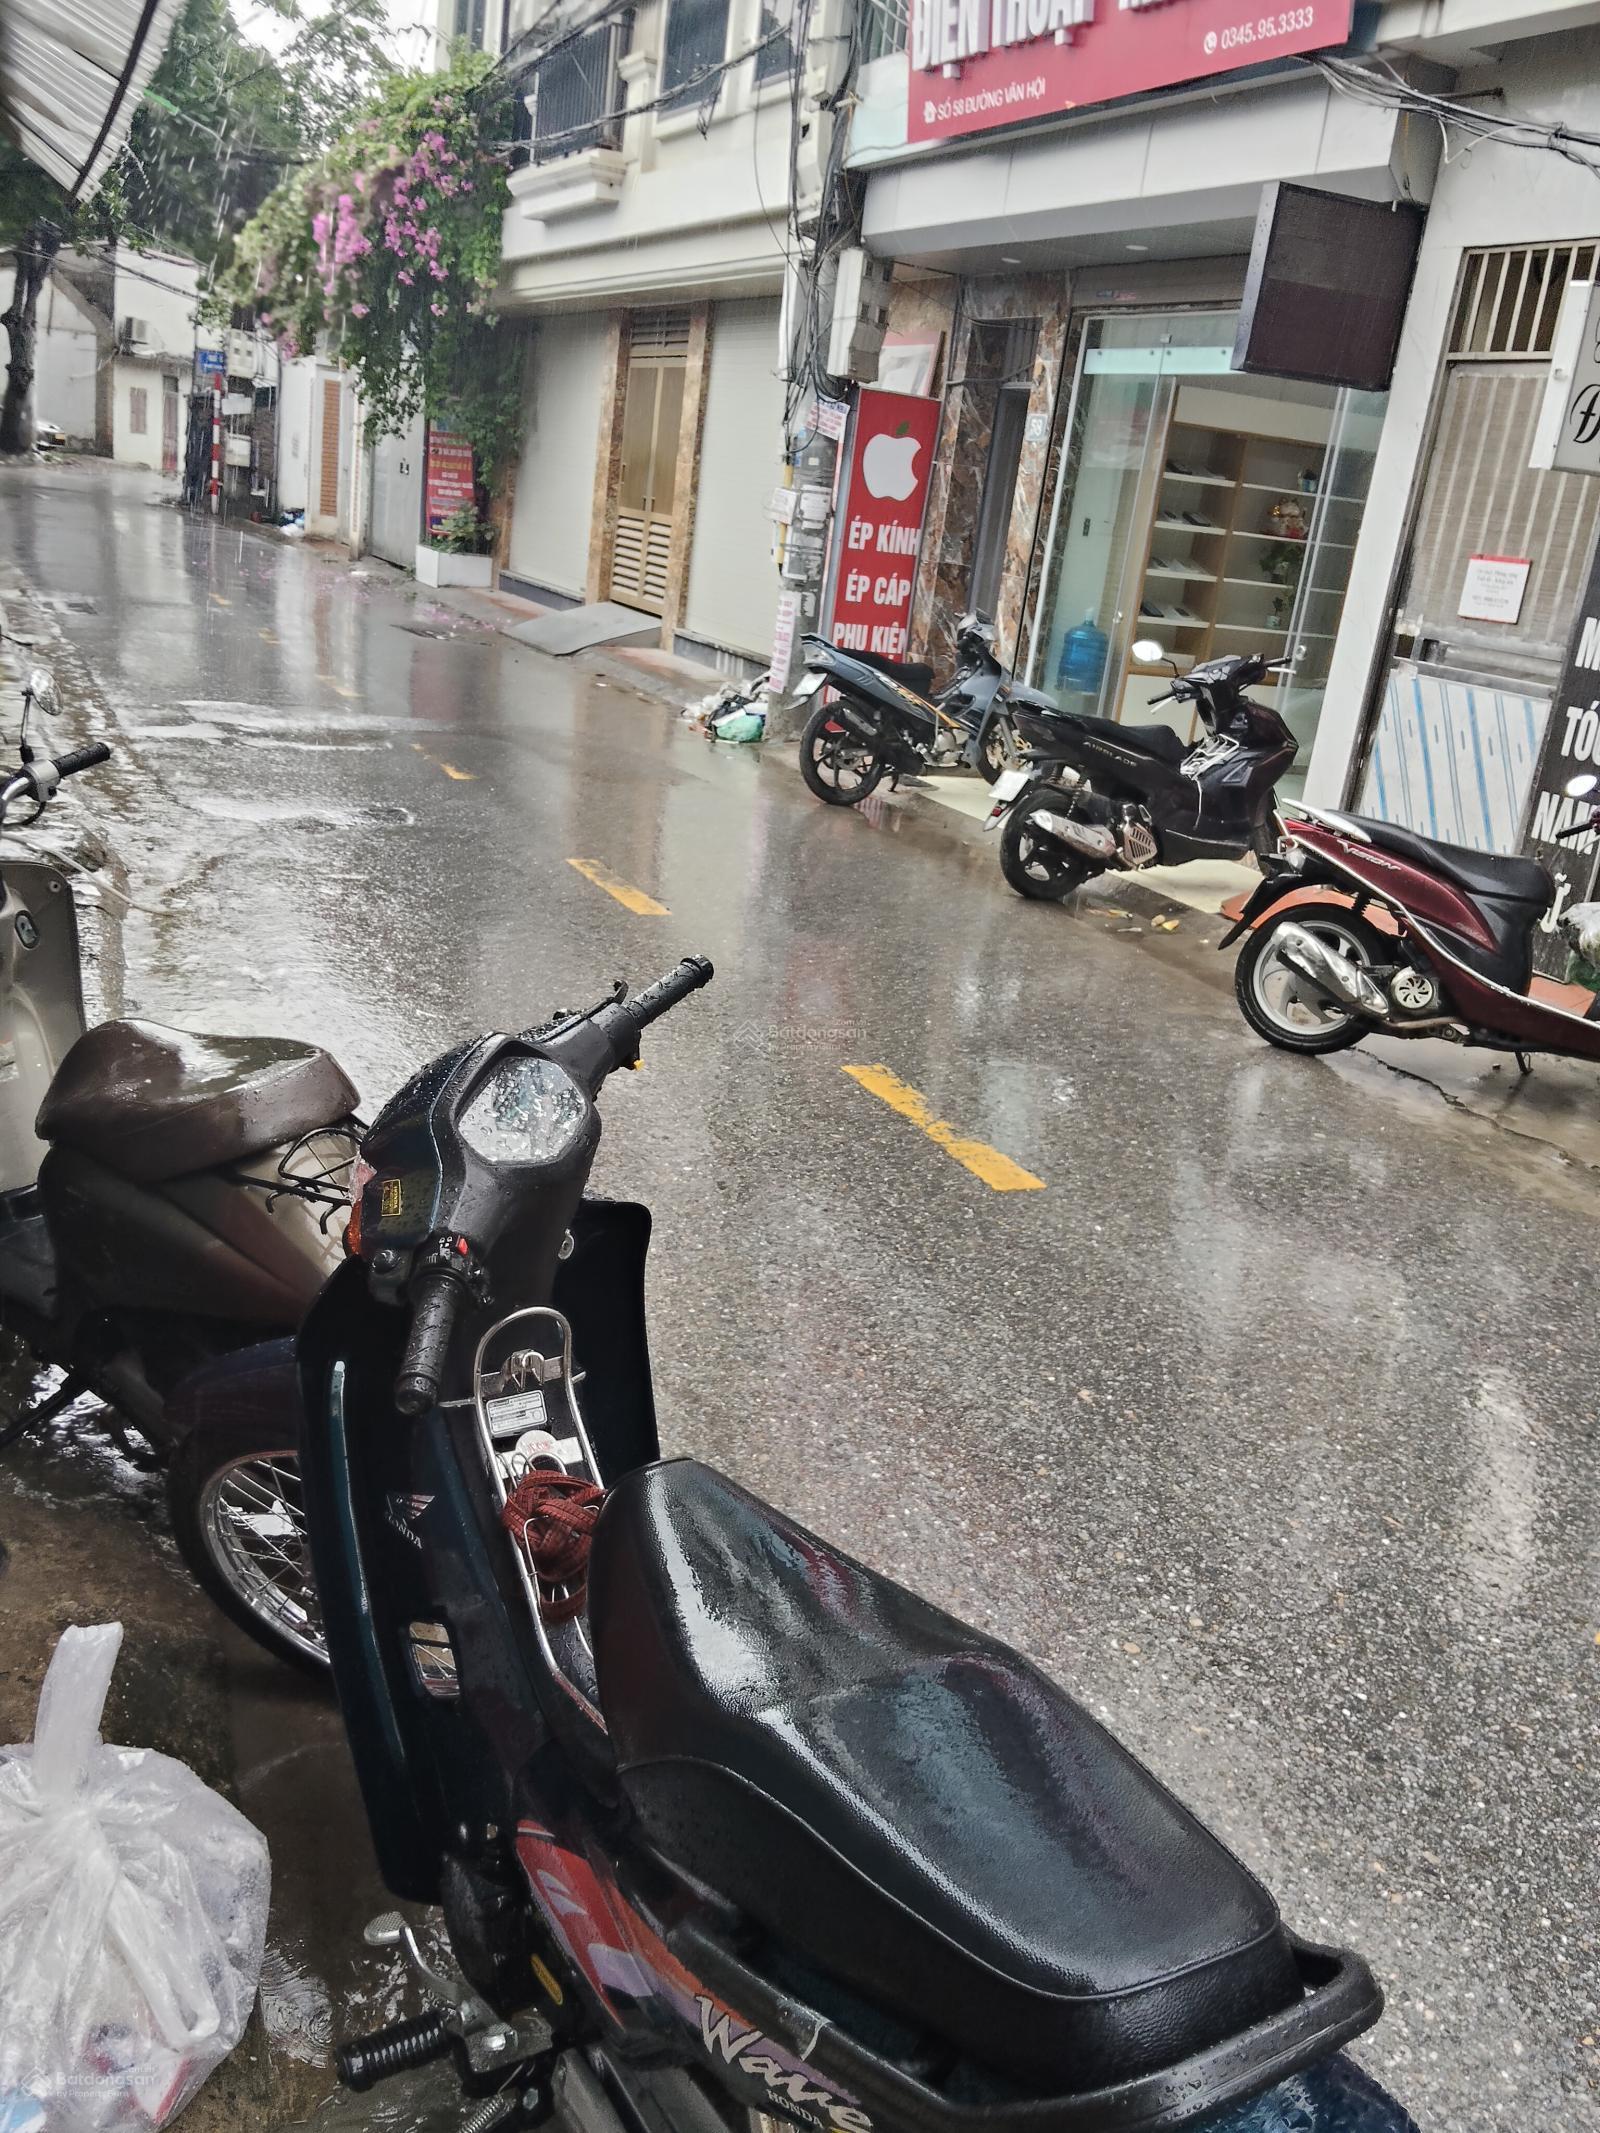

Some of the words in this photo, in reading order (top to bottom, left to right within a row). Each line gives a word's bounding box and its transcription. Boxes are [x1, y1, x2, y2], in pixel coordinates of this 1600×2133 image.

[1221, 6, 1314, 49] 0345.95.3333
[847, 515, 874, 551] ÉP
[876, 520, 921, 556] KÍNH
[845, 568, 870, 603] ÉP
[873, 572, 911, 606] CÁP
[766, 2089, 824, 2130] HONDA
